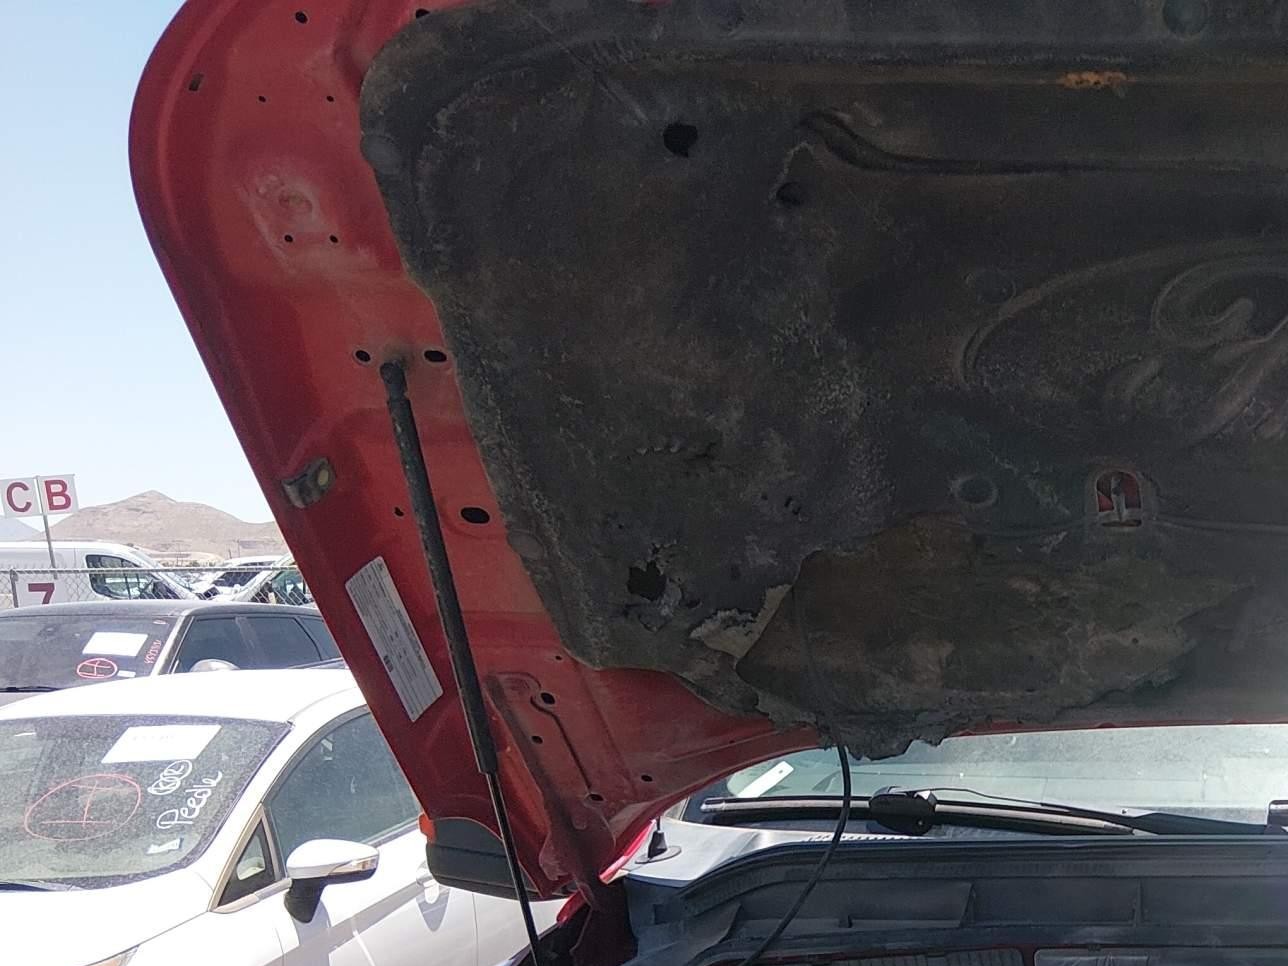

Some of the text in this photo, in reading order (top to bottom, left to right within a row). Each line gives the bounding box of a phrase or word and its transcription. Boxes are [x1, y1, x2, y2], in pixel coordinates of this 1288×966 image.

[6, 481, 32, 513] C
[44, 479, 72, 511] B
[27, 582, 55, 605] 7
